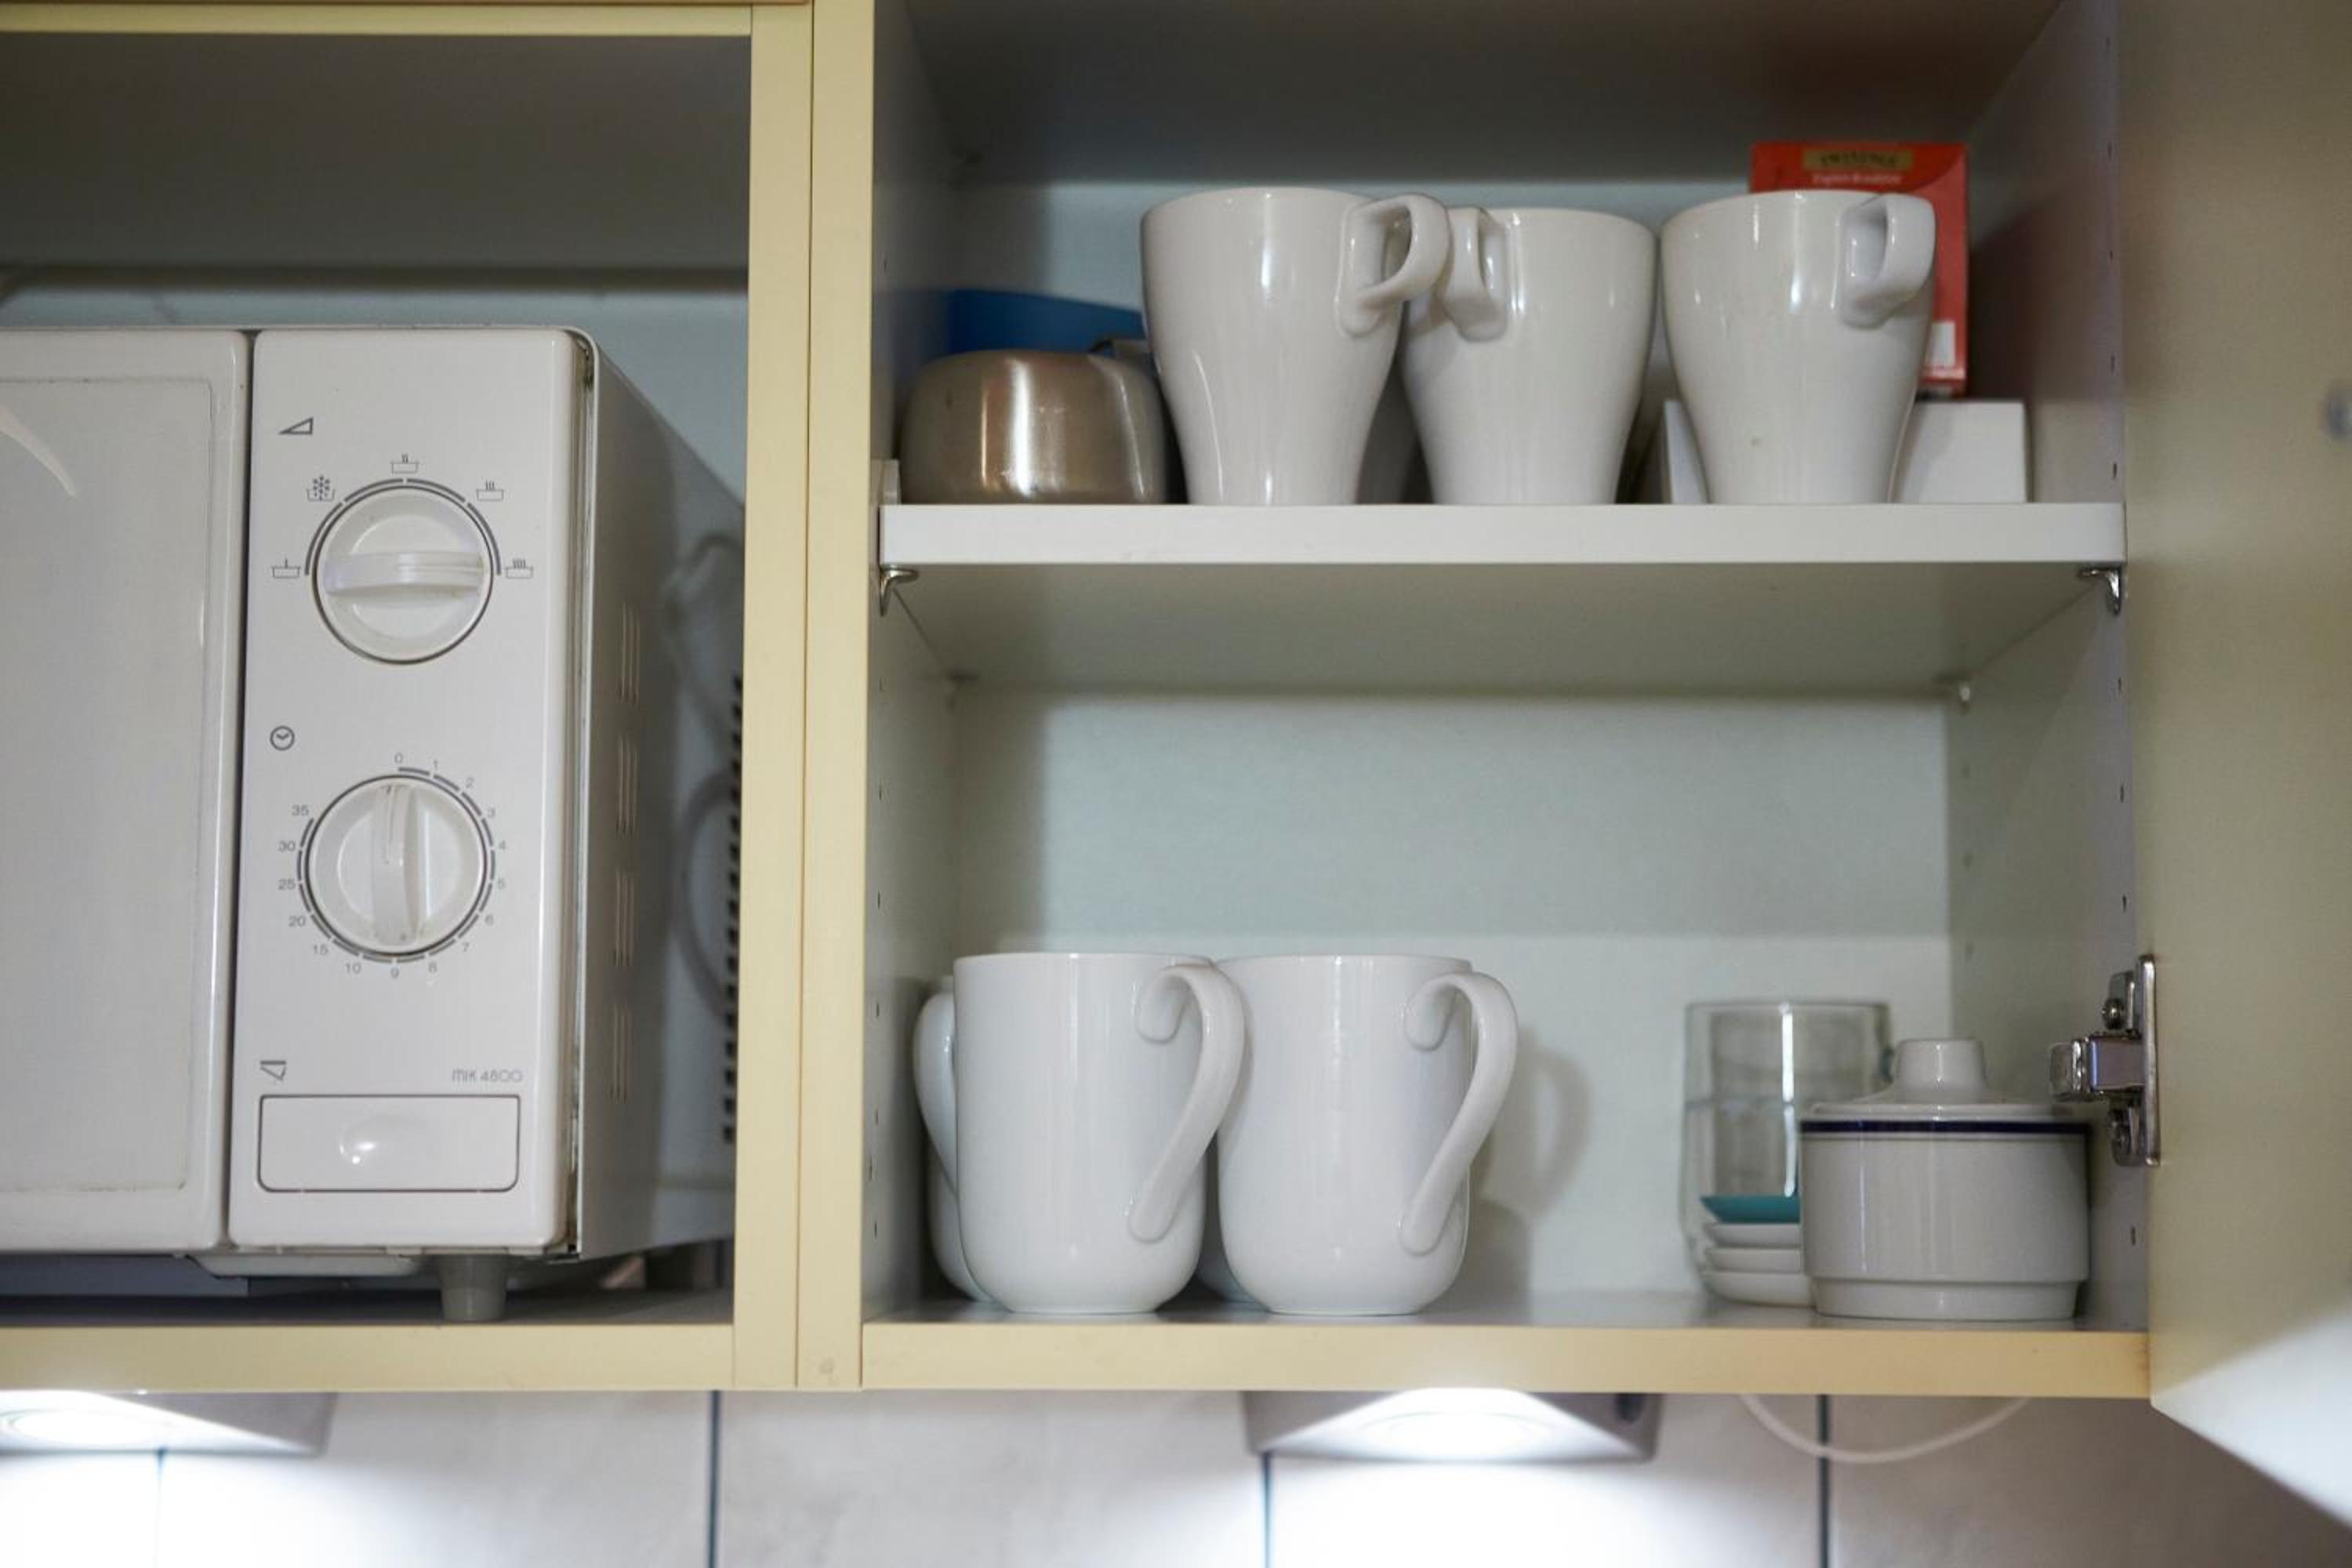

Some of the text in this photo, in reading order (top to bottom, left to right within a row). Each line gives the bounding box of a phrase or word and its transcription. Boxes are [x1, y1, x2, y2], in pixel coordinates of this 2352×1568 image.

[433, 760, 439, 769] 1
[466, 777, 474, 789] 2
[292, 806, 309, 816] 35
[278, 841, 296, 851] 30
[278, 879, 296, 890] 25
[289, 916, 306, 927] 20
[313, 945, 328, 955] 15
[345, 963, 361, 974] 10
[480, 1069, 524, 1083] 4800
